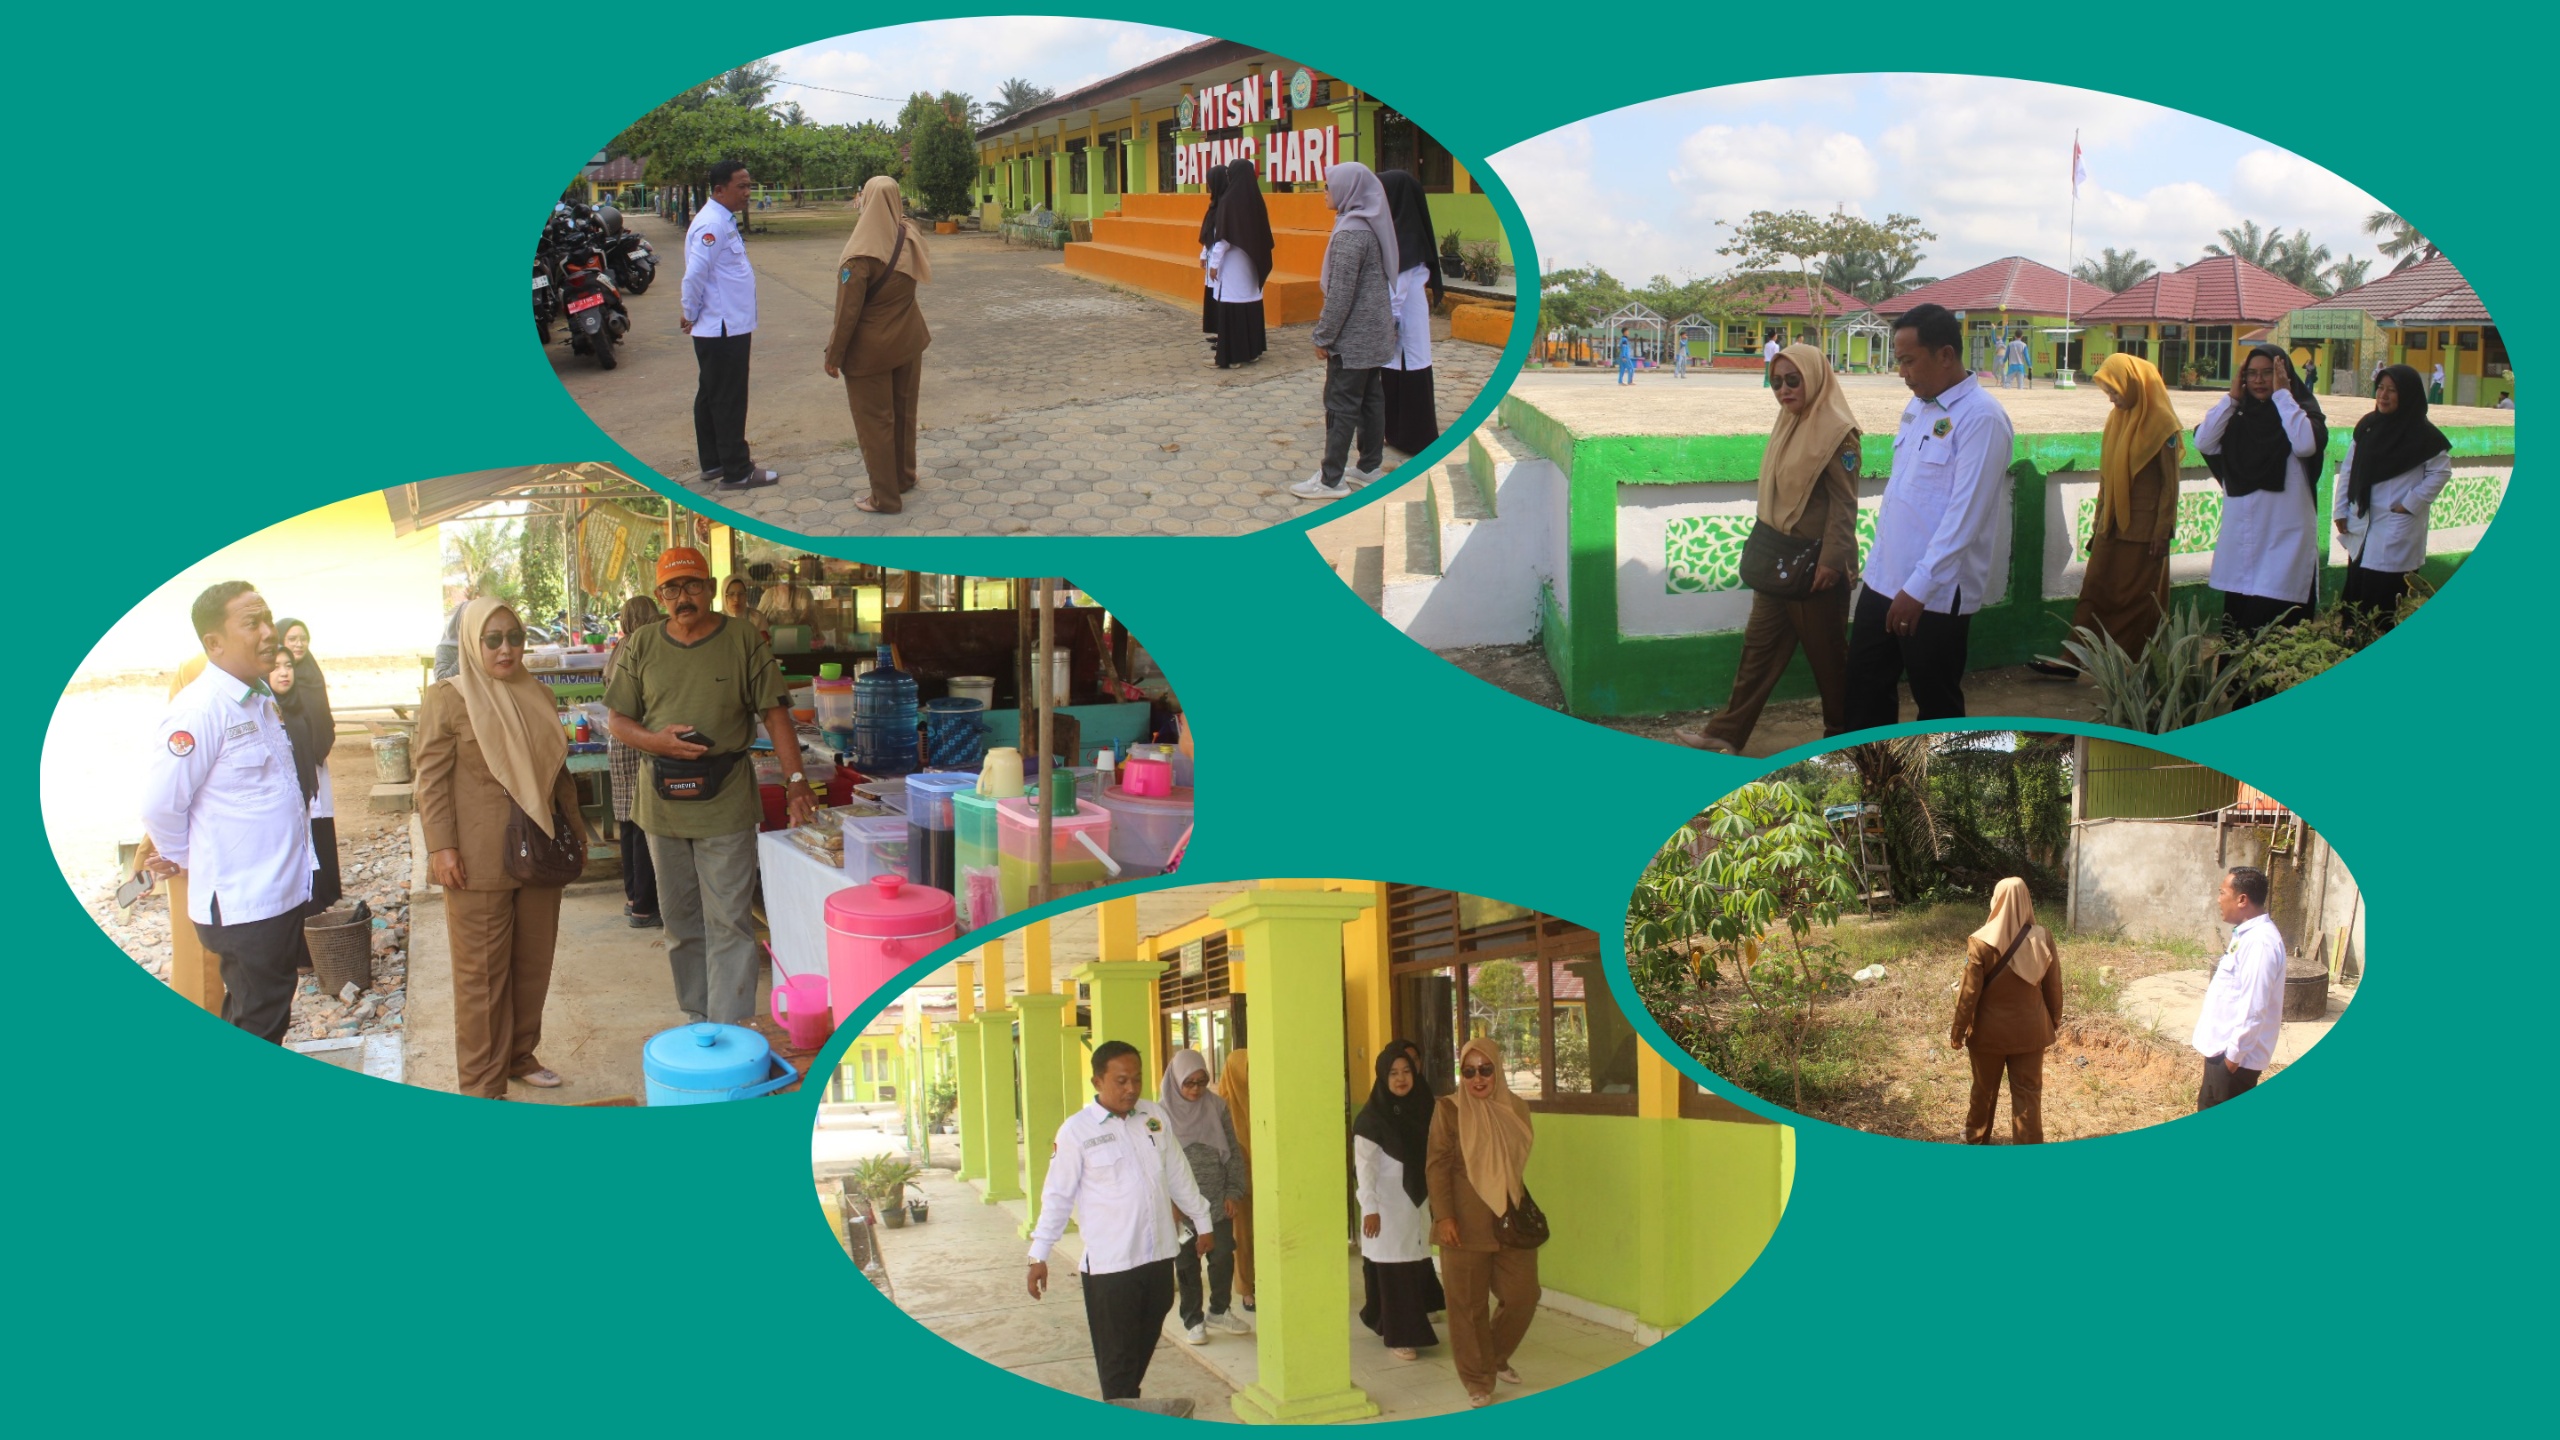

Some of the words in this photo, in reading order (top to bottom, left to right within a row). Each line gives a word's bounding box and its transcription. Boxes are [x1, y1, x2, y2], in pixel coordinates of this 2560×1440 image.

[1200, 74, 1263, 131] MTsN
[1270, 70, 1283, 120] 1
[1266, 126, 1338, 182] HARI
[670, 782, 696, 790] FOREVER
